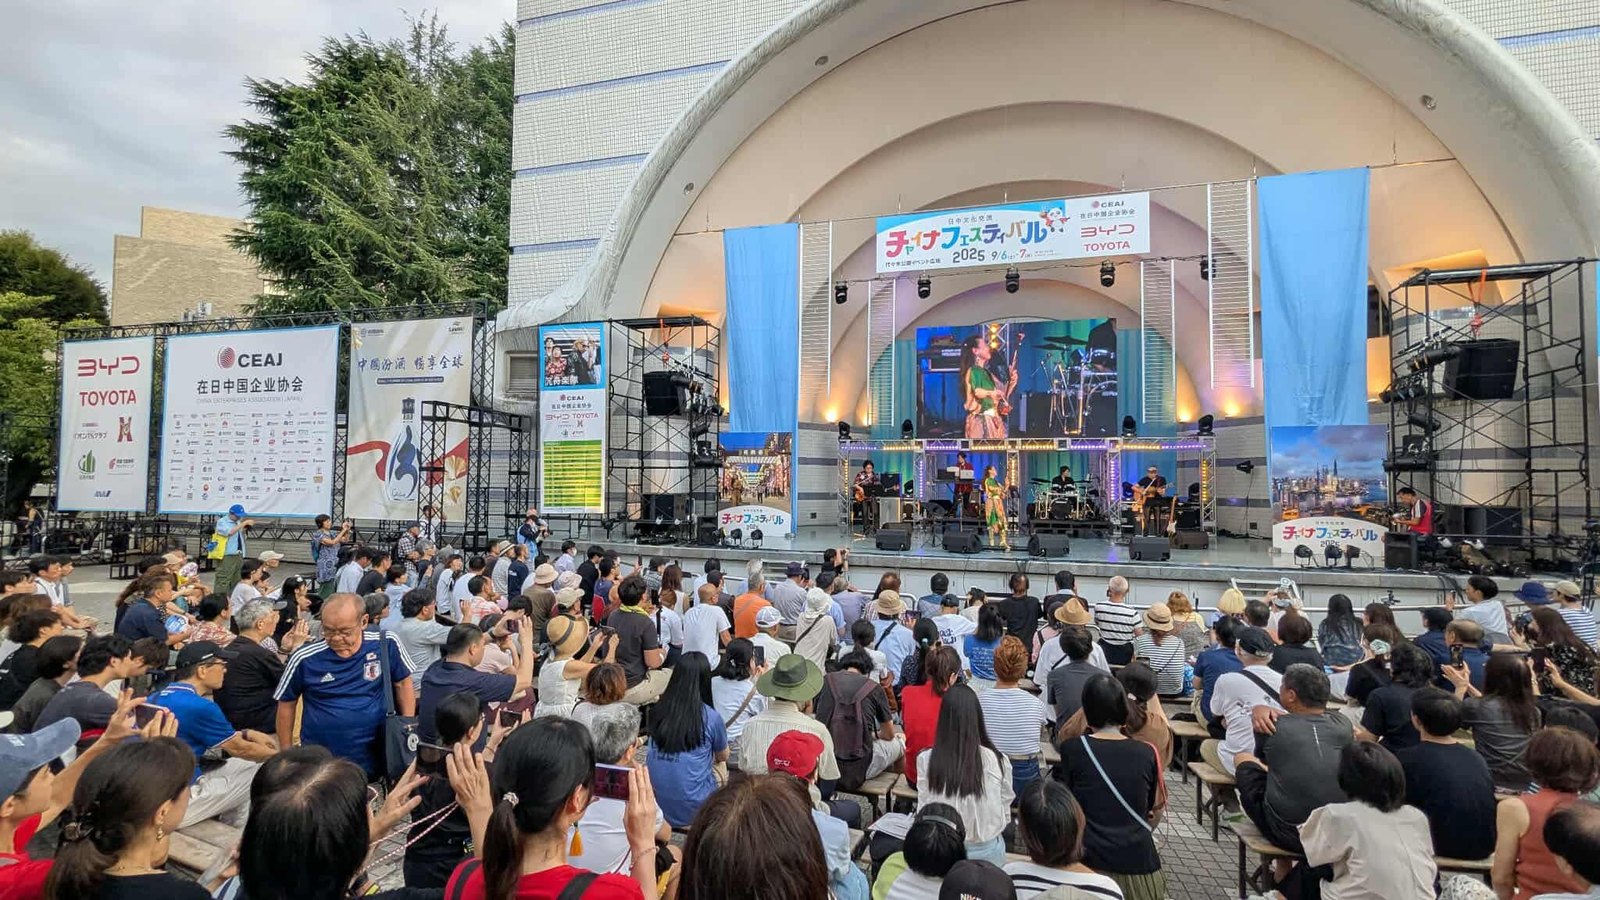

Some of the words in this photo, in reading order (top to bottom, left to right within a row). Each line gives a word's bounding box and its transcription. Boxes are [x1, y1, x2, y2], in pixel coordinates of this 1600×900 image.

[1101, 200, 1124, 208] CEAJ
[1081, 223, 1135, 238] BYD
[886, 220, 1048, 258] チャイナフェスティバル
[1084, 240, 1131, 252] TOYOTA
[952, 247, 986, 263] 2025
[78, 356, 140, 377] BYD
[238, 353, 283, 368] CEAJ
[197, 376, 303, 394] 在日中国企业协会
[79, 389, 137, 407] TOYOTA
[1282, 525, 1378, 541] チャイナフェスティバル
